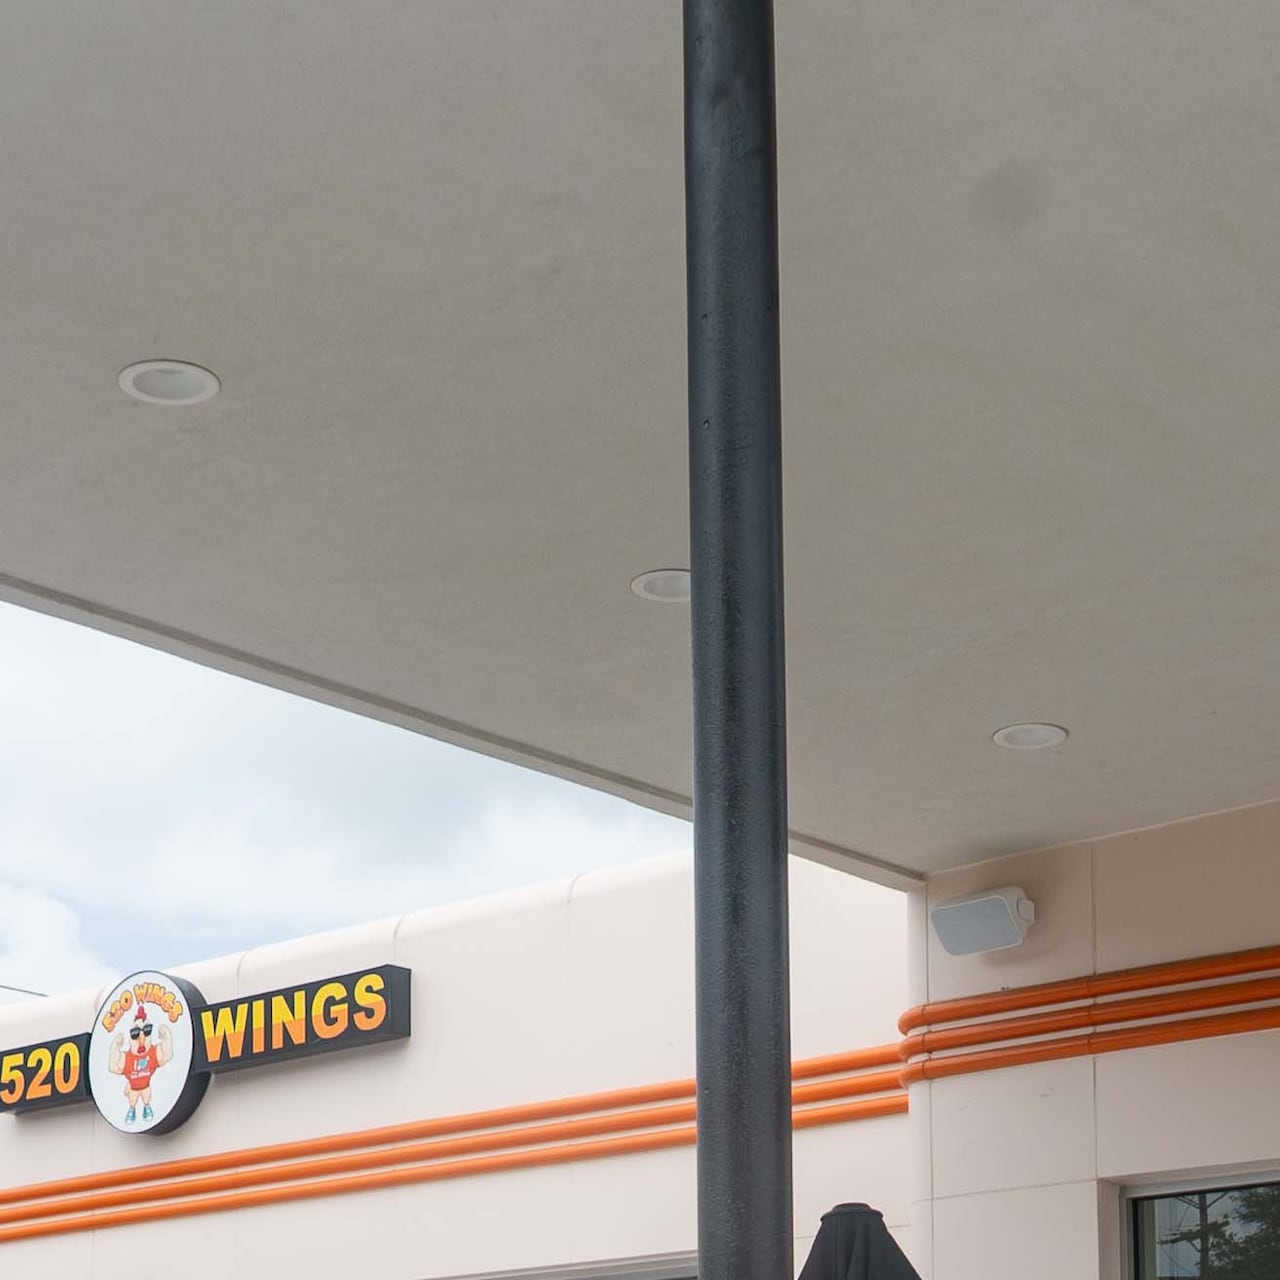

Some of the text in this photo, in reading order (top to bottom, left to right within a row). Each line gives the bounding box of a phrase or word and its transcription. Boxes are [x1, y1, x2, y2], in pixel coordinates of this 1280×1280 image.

[0, 973, 388, 1105] 520 WINGS
[133, 982, 184, 1023] WINGS
